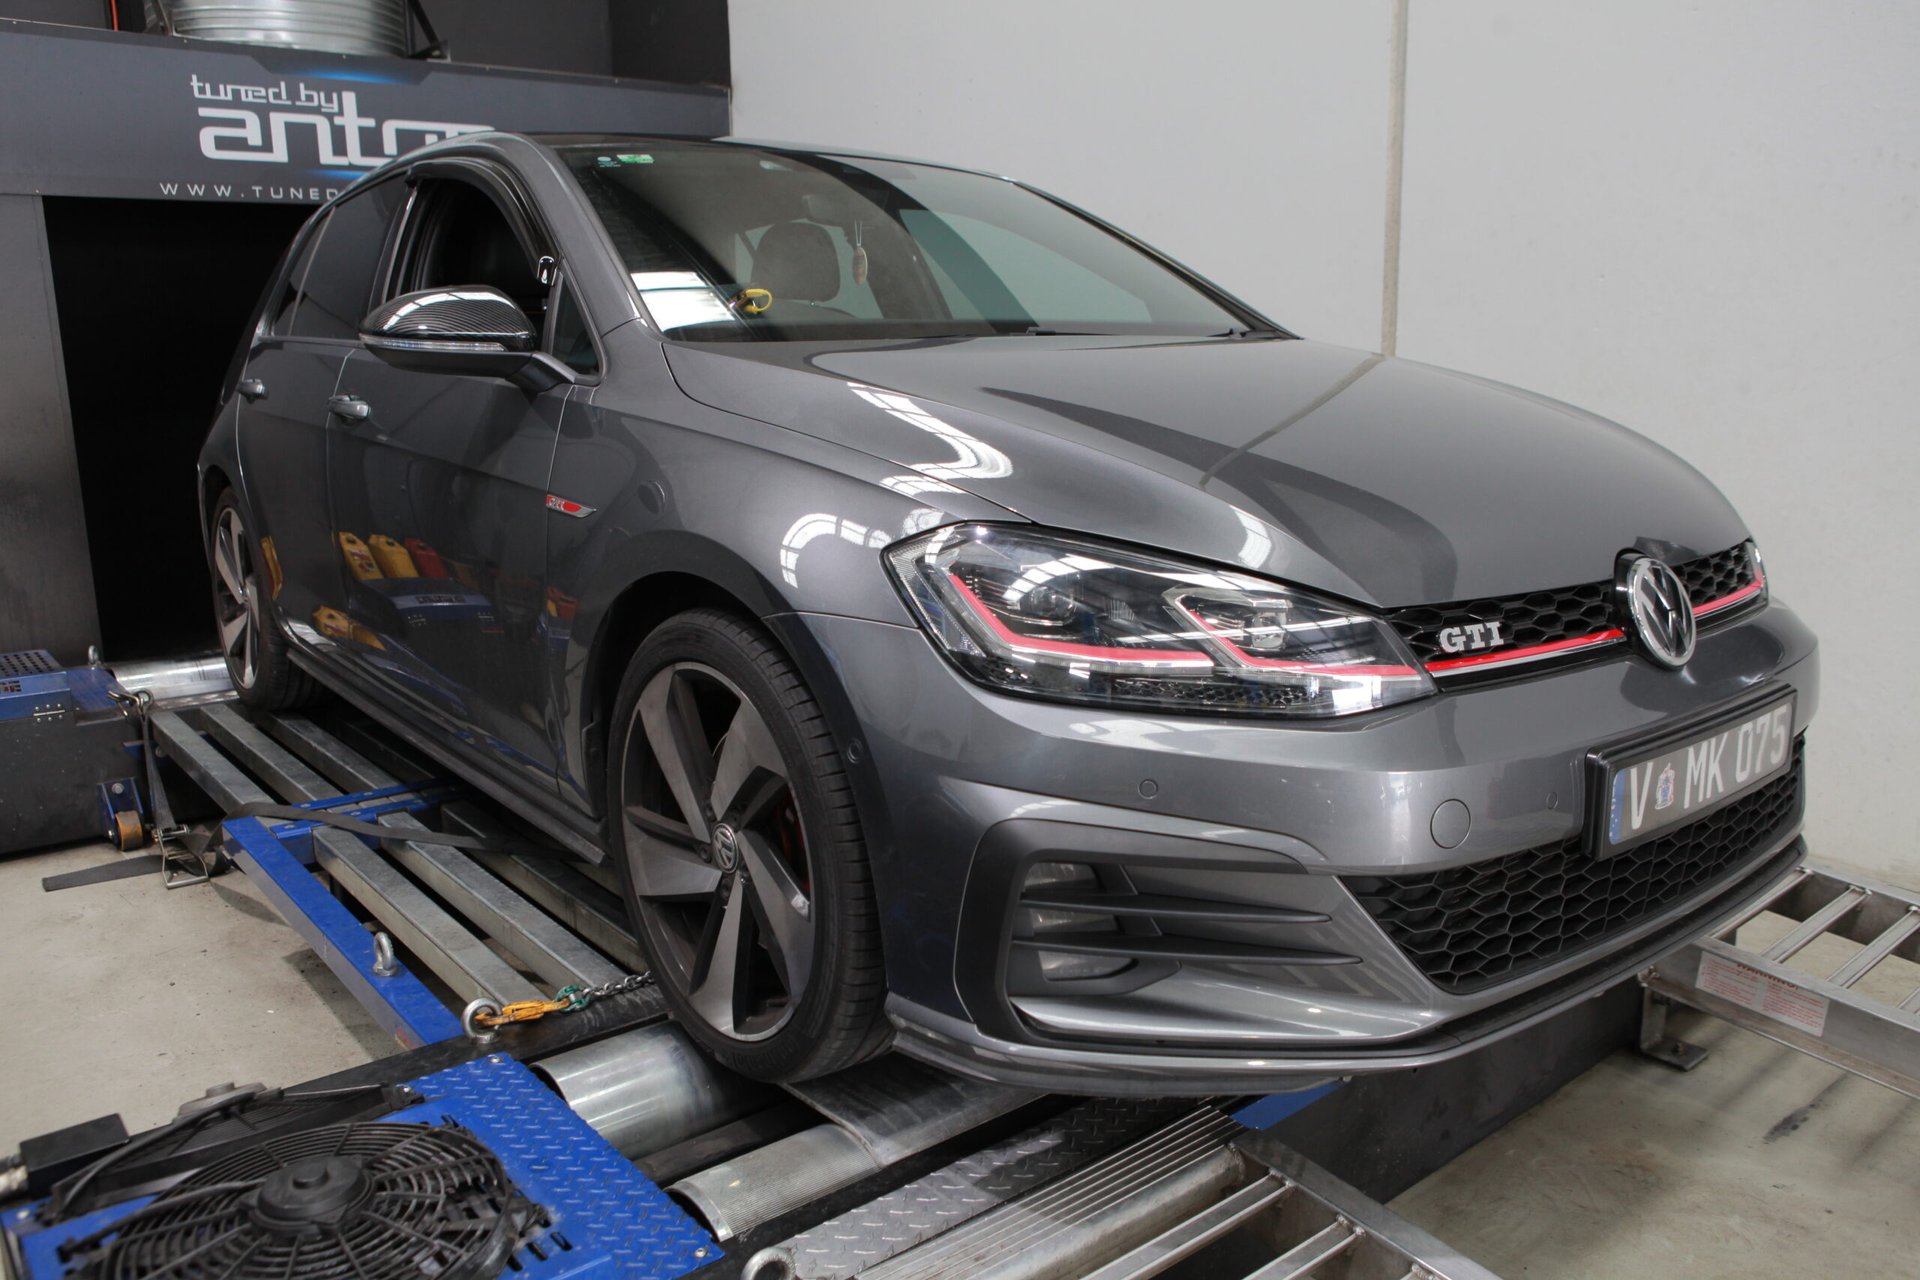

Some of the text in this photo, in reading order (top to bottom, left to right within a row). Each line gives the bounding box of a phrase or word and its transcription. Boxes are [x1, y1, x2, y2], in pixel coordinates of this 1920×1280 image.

[190, 74, 339, 113] tuned by
[198, 90, 496, 167] anto
[1439, 621, 1504, 654] GTI
[1630, 704, 1787, 830] V MK 075
